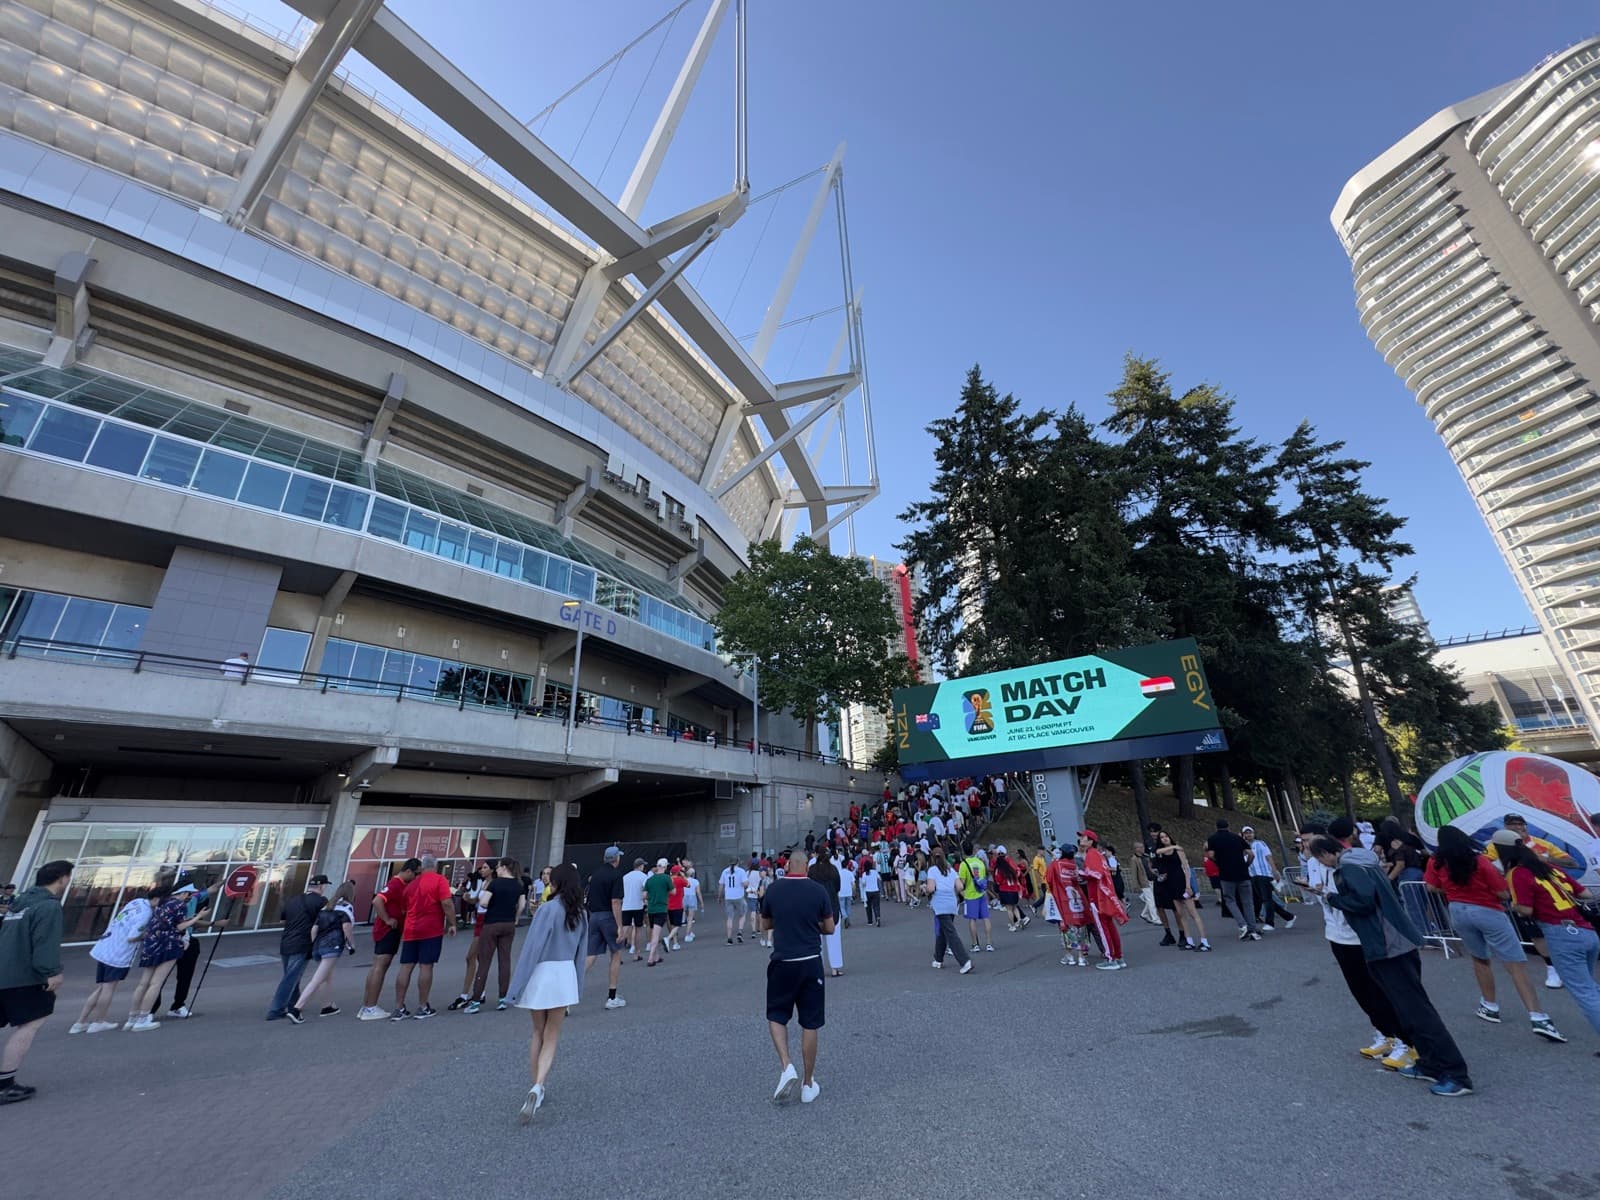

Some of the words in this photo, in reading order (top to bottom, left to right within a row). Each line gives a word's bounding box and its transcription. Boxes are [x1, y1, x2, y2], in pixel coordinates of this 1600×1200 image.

[560, 606, 602, 631] GATE
[607, 619, 617, 635] D
[1000, 667, 1107, 702] MATCH
[1181, 655, 1210, 710] EGY
[1004, 695, 1082, 723] DAY
[897, 703, 910, 749] NZL
[973, 723, 988, 731] FIFA
[1007, 727, 1025, 735] JUNE
[1028, 731, 1050, 739] PLACE
[1051, 725, 1095, 736] VANCOUVER
[967, 734, 997, 742] VANCOUVER
[728, 876, 735, 888] 11
